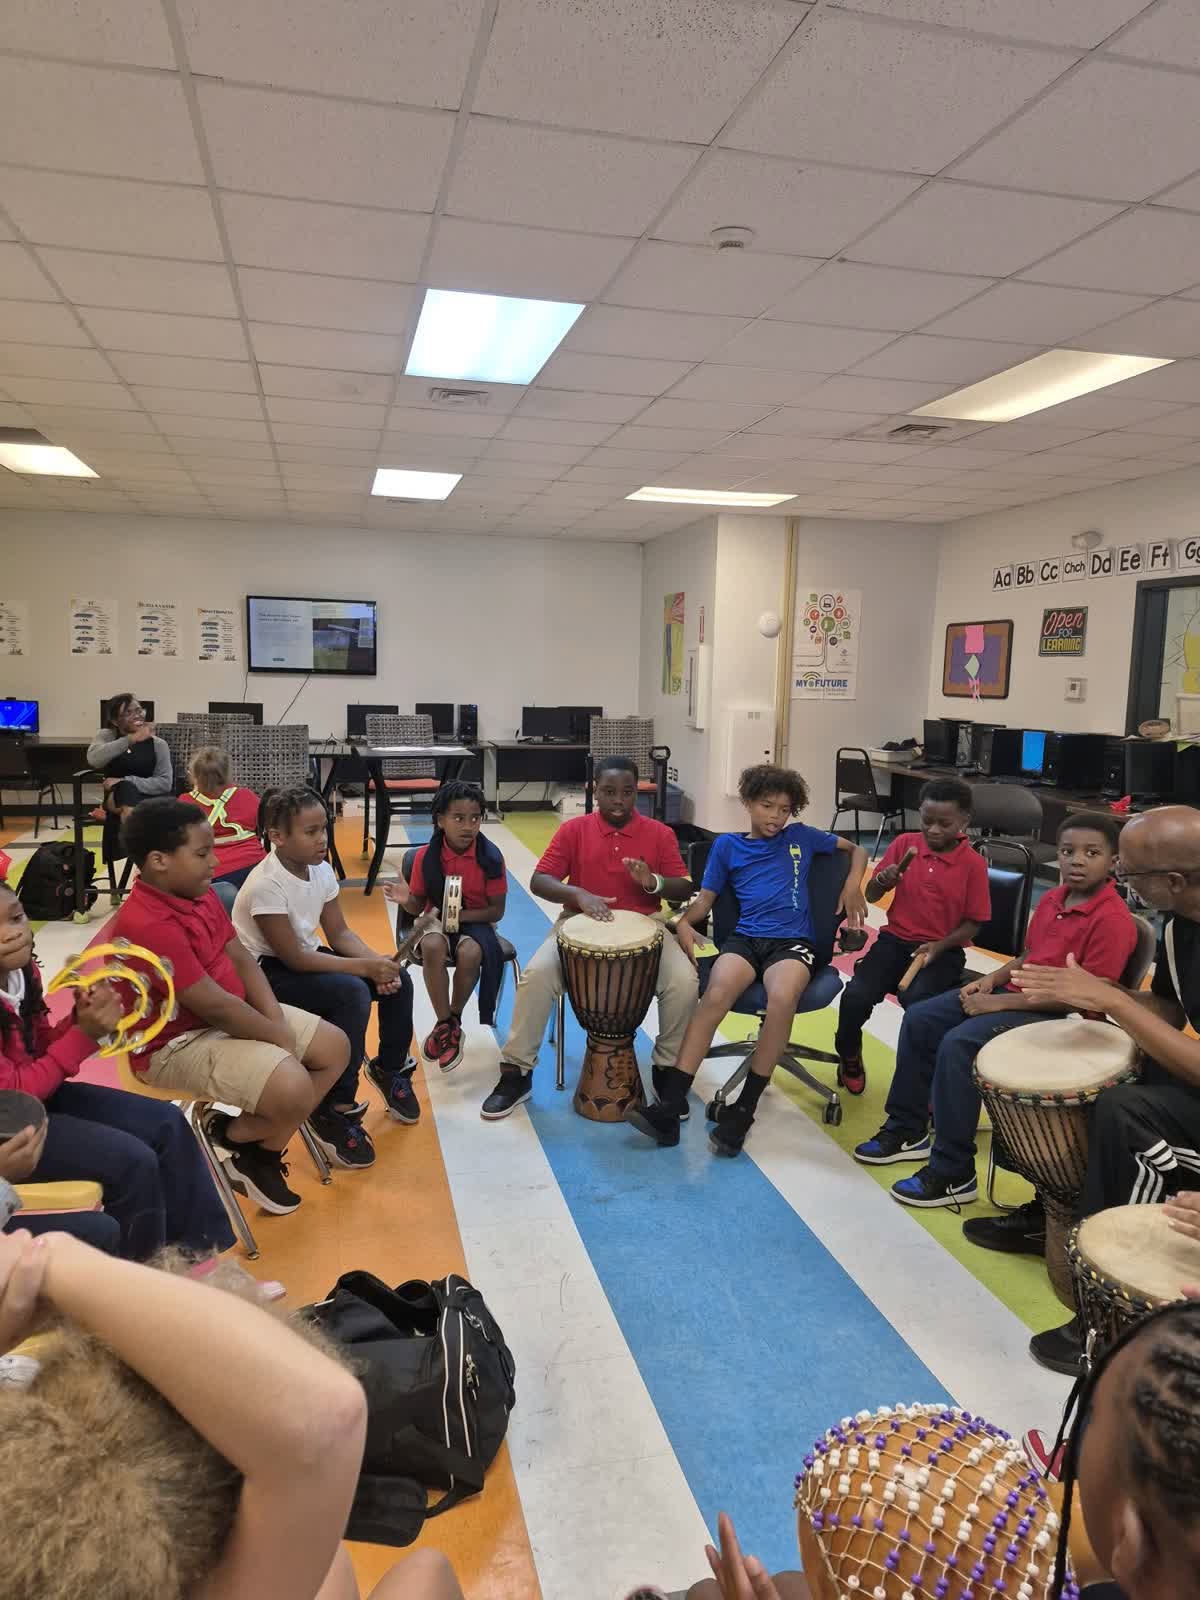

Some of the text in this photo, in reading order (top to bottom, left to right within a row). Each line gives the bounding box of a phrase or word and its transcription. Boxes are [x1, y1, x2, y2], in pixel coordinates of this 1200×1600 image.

[993, 570, 1011, 588] Aa
[1016, 565, 1034, 585] Bb
[1041, 562, 1058, 581] Cc
[1064, 560, 1085, 574] Chch
[1091, 551, 1112, 574] Dd
[1120, 550, 1140, 571] Ee
[1043, 611, 1083, 635] Open
[1059, 628, 1073, 637] FOR
[1042, 638, 1081, 651] LEARNING
[795, 679, 848, 688] MY FUTURE
